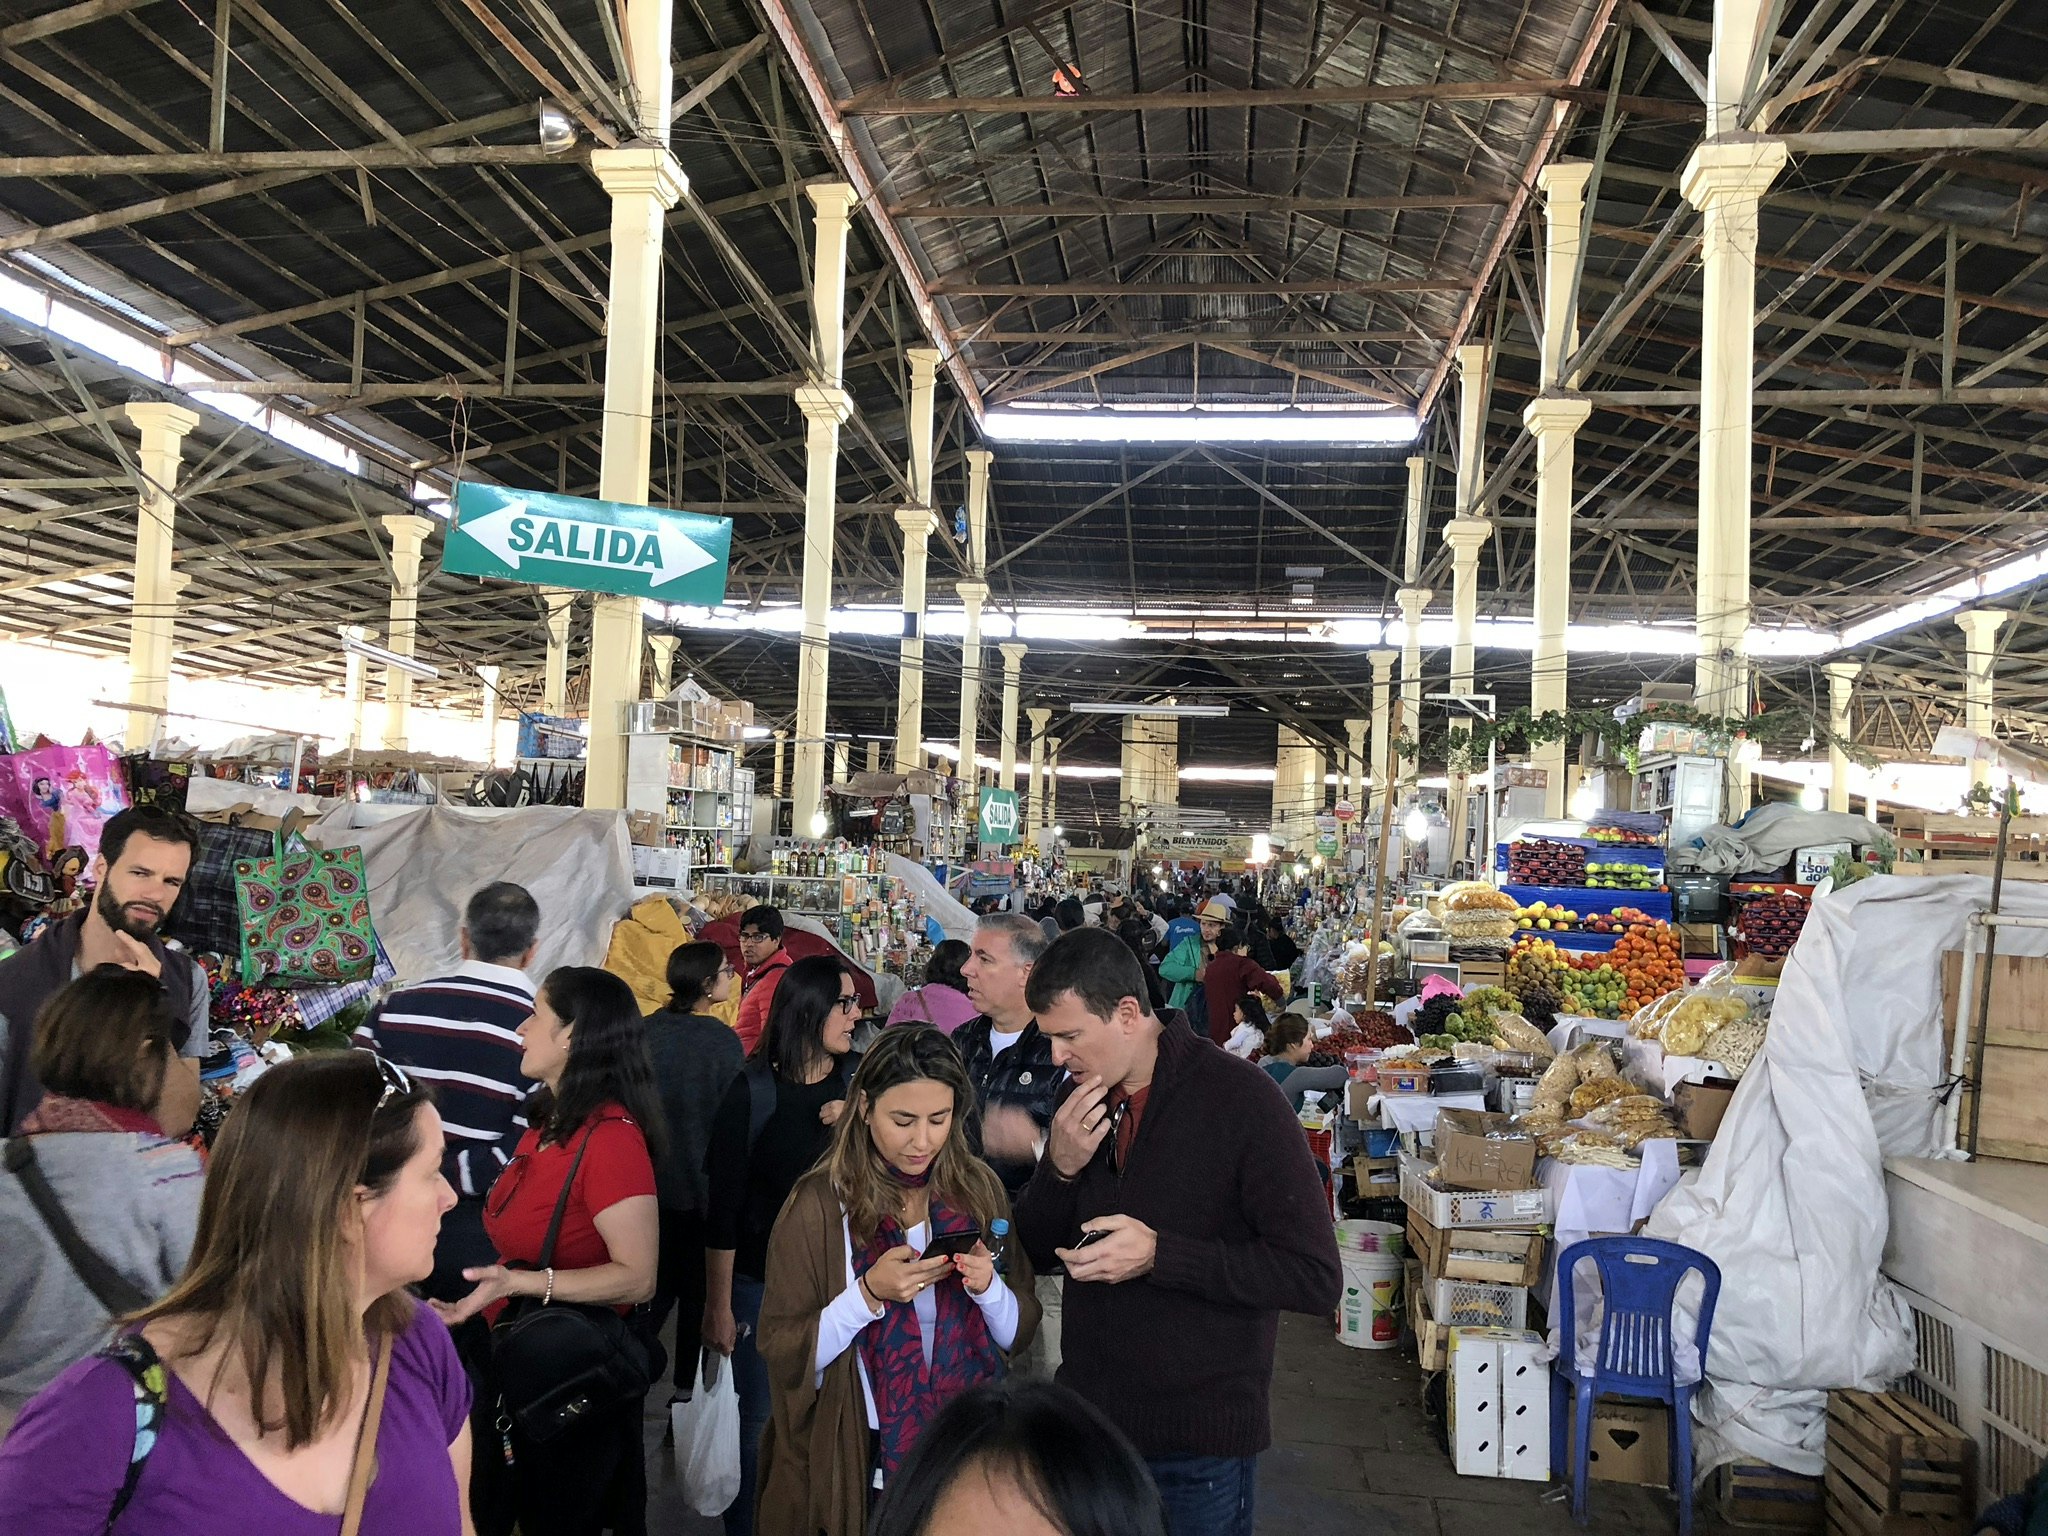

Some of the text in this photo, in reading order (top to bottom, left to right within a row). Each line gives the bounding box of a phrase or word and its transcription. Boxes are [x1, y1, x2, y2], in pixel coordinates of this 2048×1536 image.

[507, 517, 664, 570] SALIDA
[989, 803, 1012, 827] SALIDA
[1172, 836, 1228, 847] BIENVENIDOS
